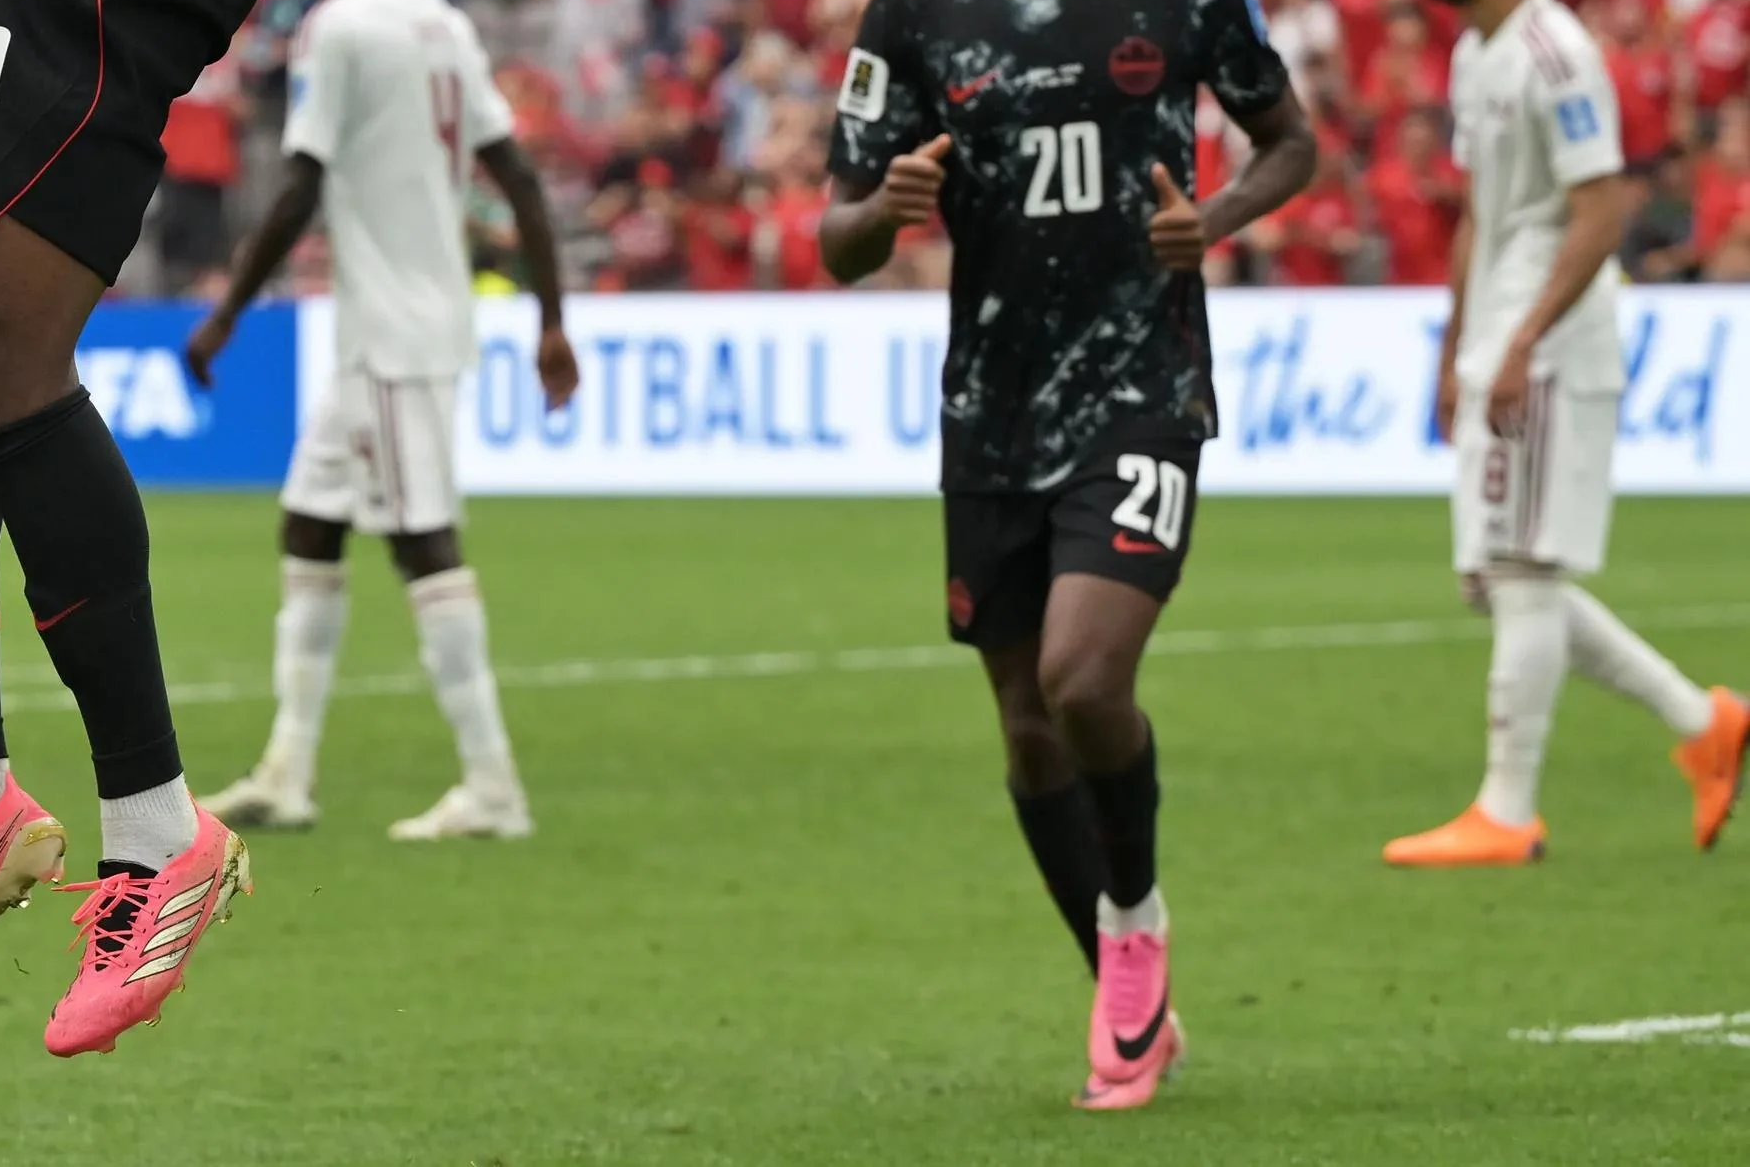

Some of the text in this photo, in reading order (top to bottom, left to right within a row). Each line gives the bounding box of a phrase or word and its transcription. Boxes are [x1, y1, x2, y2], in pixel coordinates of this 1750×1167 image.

[1020, 121, 1102, 217] 20
[478, 336, 846, 448] OTBALL
[1234, 315, 1392, 451] the
[1112, 453, 1188, 551] 20
